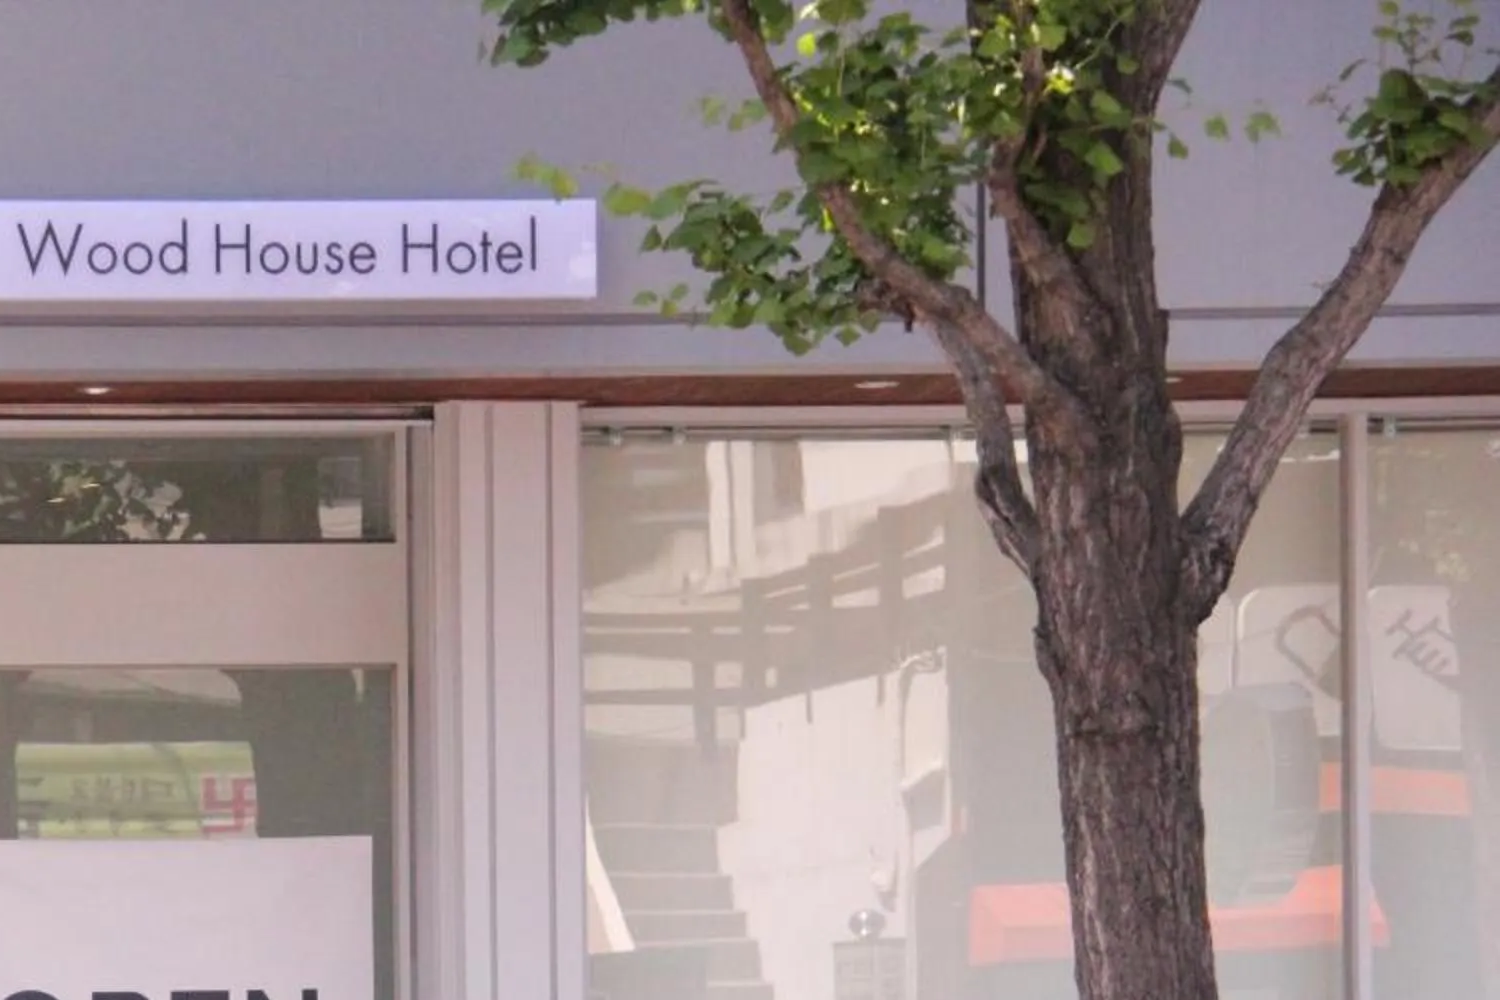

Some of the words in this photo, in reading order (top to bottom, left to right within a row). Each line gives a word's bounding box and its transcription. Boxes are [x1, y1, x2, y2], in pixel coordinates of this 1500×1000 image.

[16, 217, 189, 276] Wood
[214, 223, 377, 275] House
[401, 215, 537, 274] Hotel
